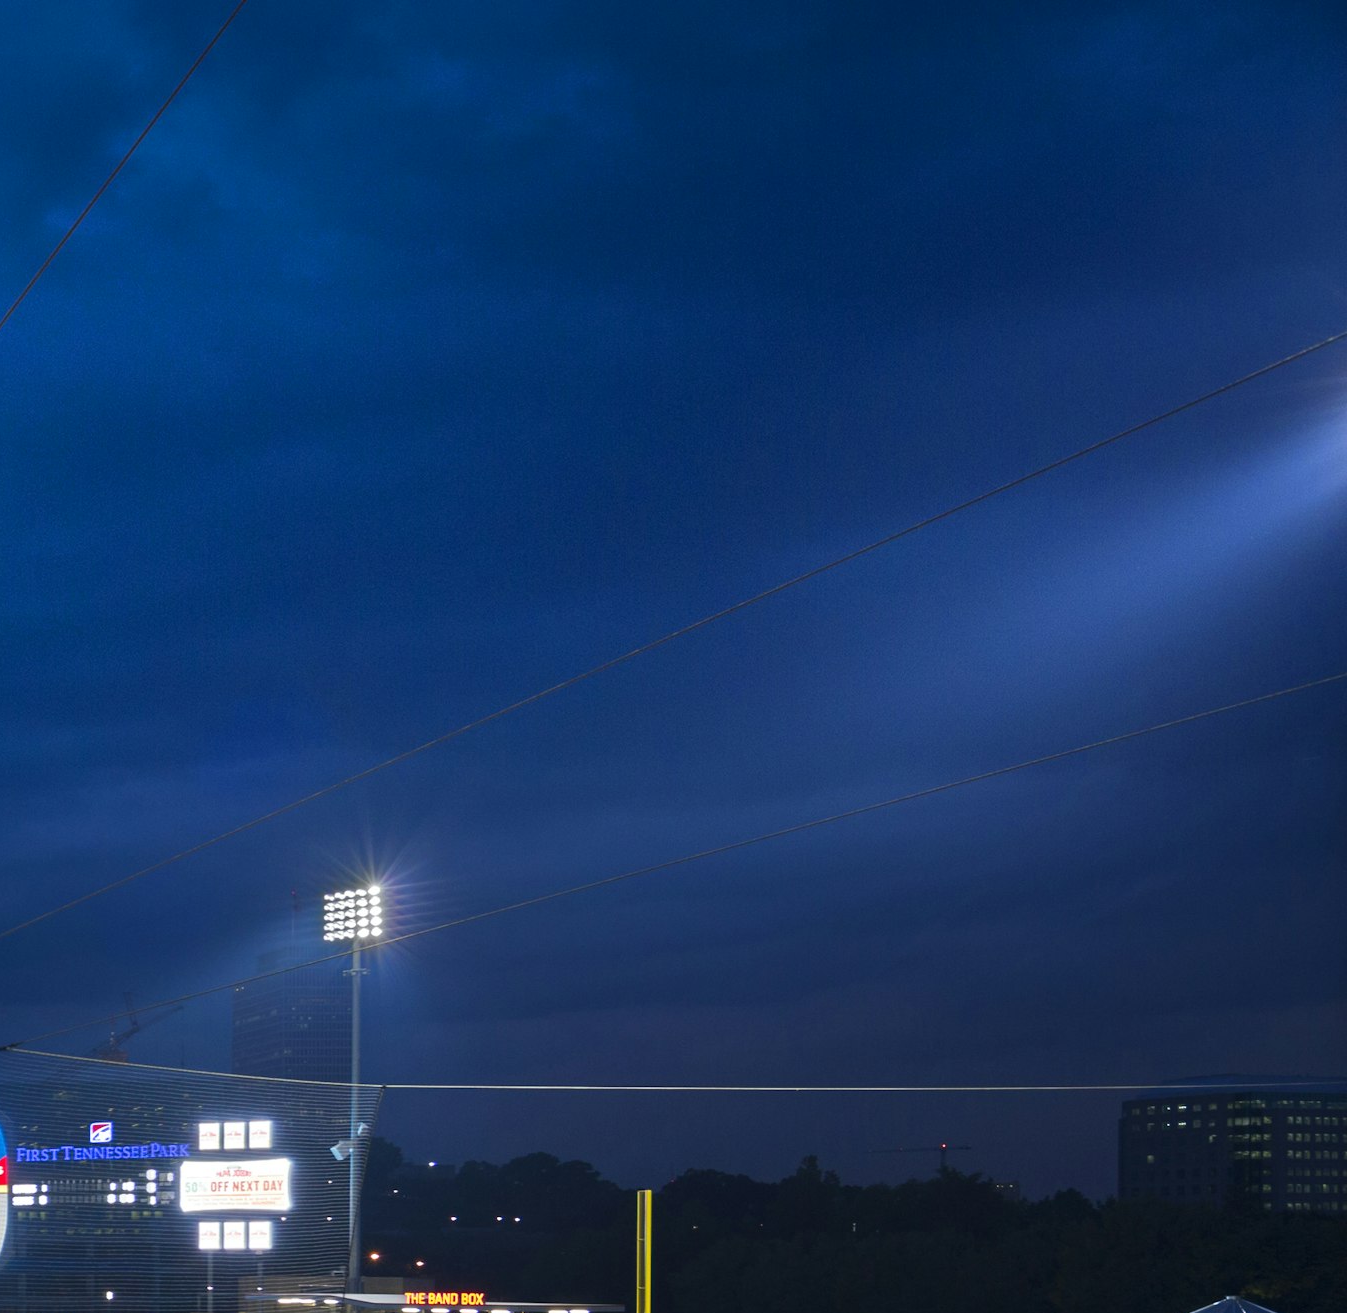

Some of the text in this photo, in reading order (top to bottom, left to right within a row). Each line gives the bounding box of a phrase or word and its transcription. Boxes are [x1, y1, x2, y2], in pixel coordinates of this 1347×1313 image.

[16, 1143, 190, 1162] FIRST TENNESSEE PARK
[210, 1181, 229, 1192] OFF
[232, 1181, 260, 1192] NEXT
[263, 1180, 283, 1191] DAY
[404, 1292, 484, 1305] THE BAND BOX
